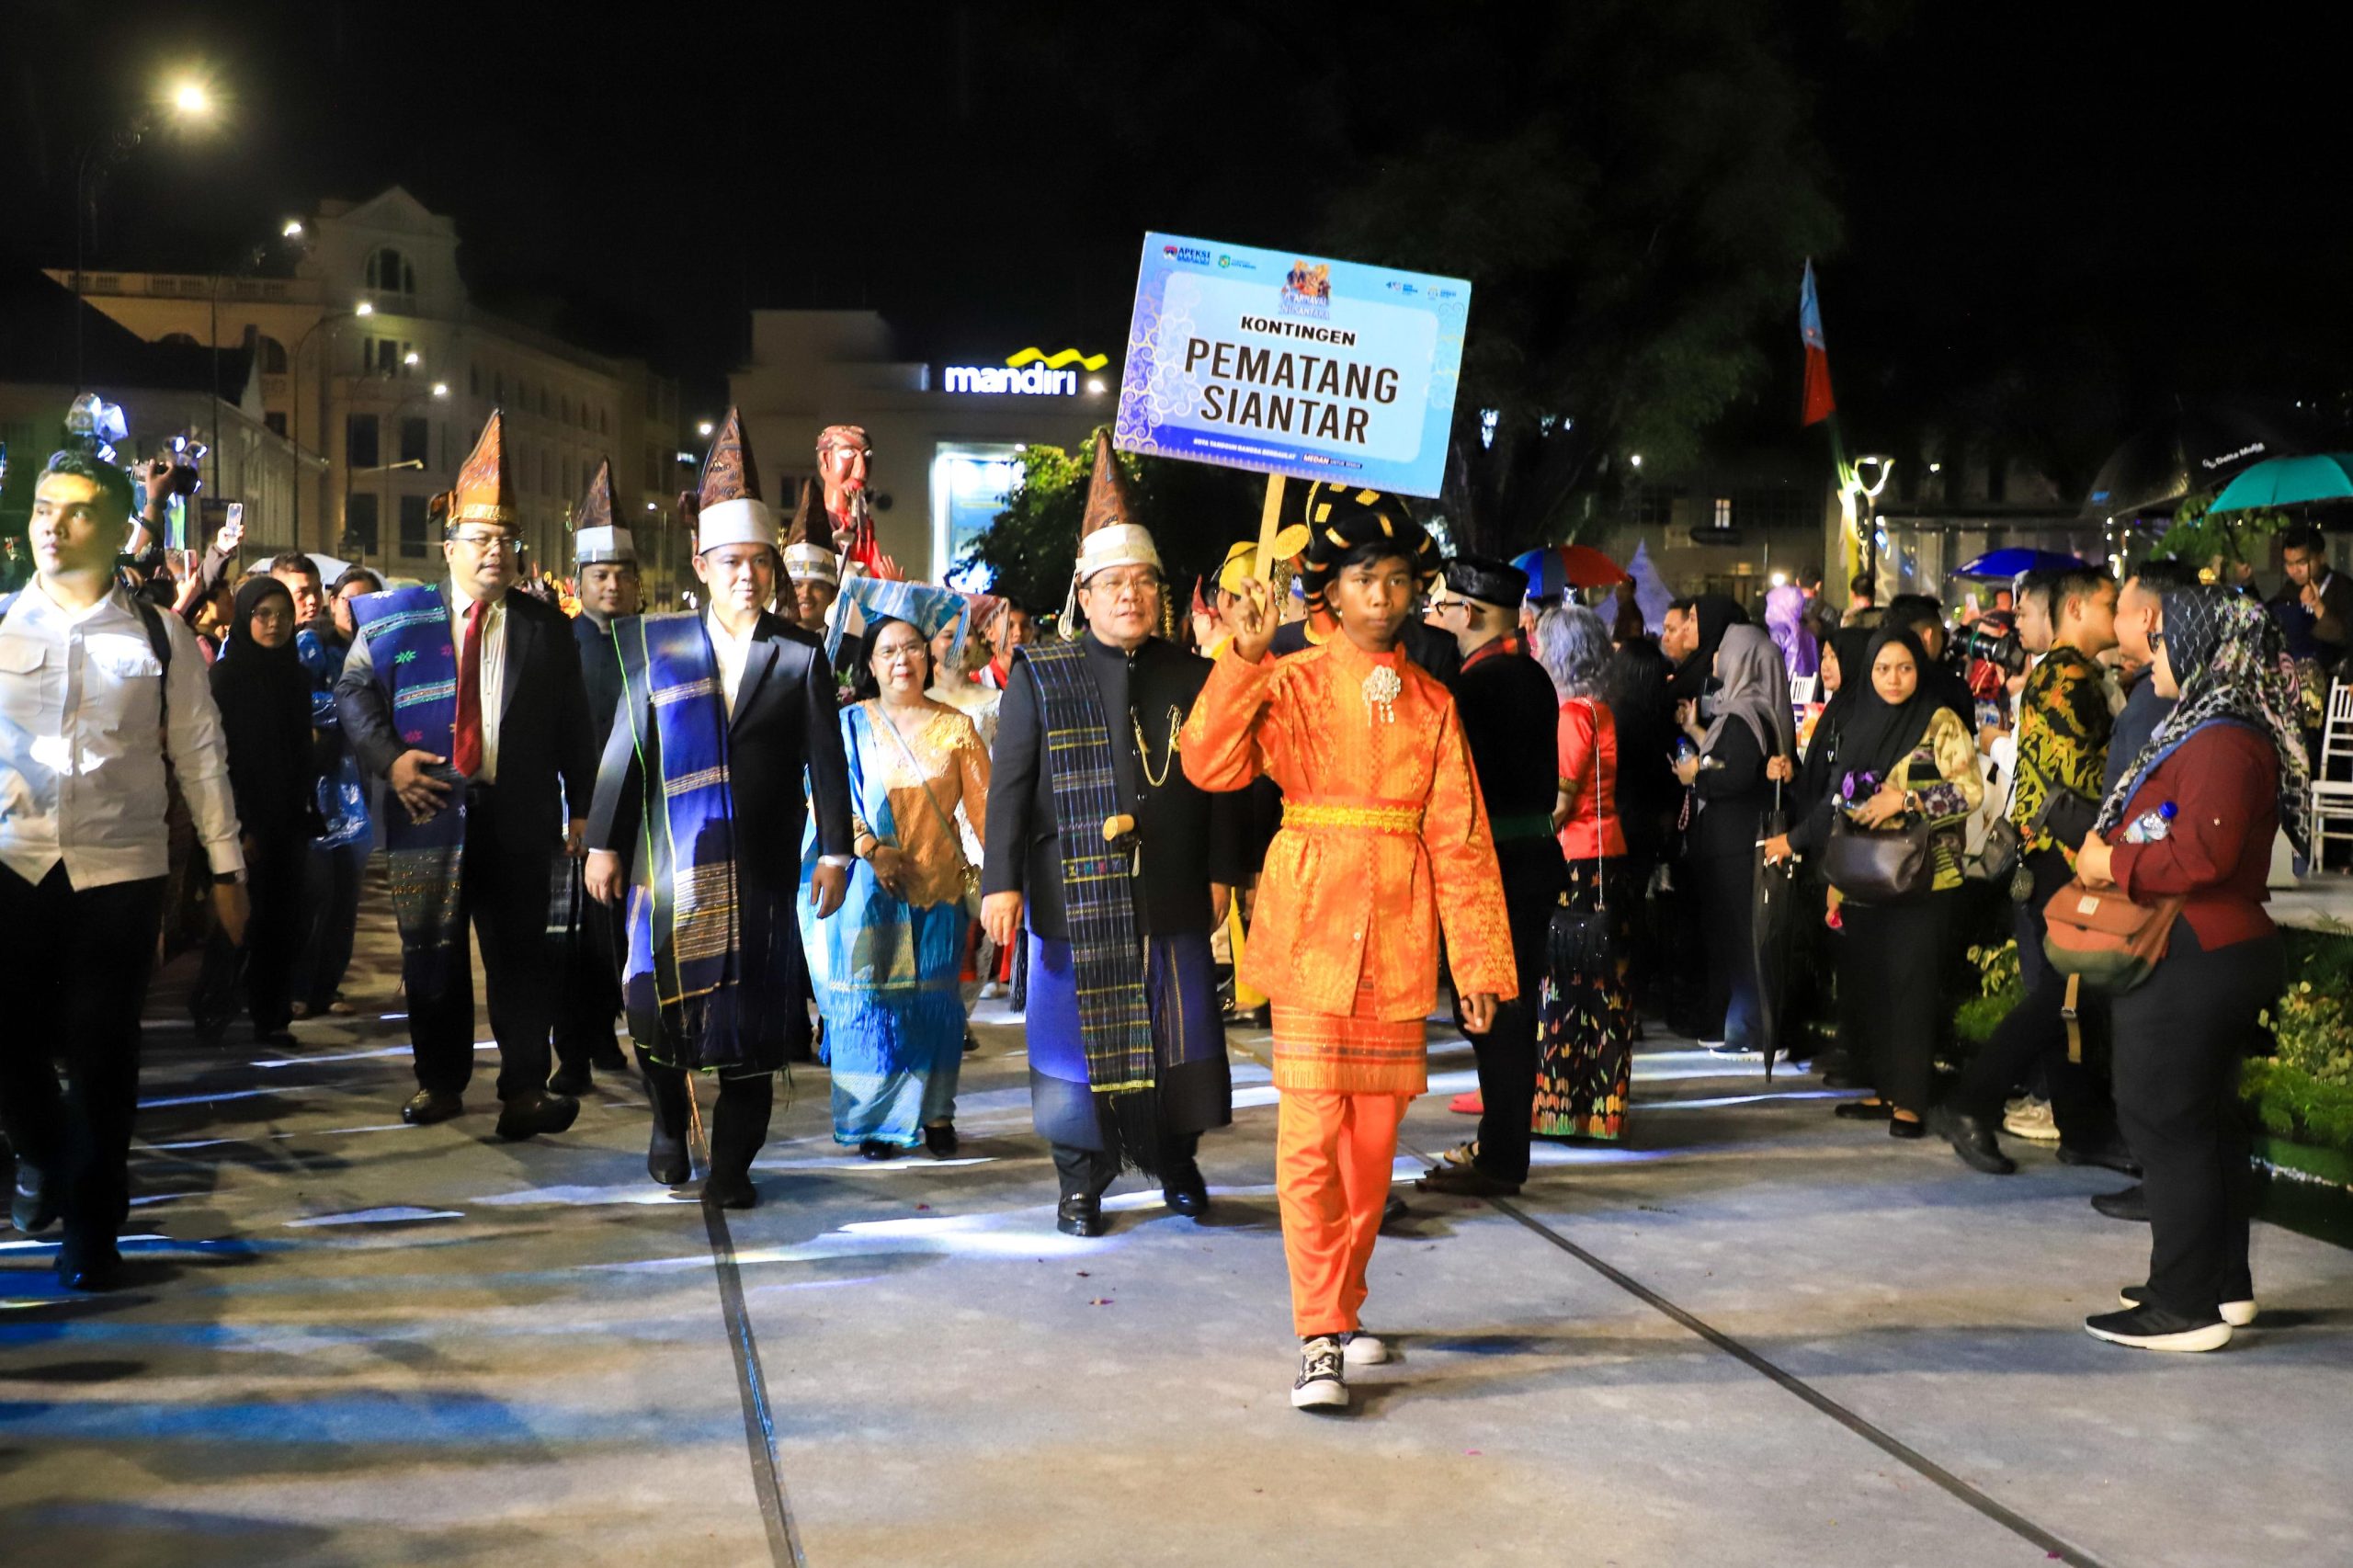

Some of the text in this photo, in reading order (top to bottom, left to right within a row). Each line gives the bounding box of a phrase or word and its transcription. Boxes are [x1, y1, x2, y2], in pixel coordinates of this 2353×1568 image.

[1177, 246, 1211, 258] APEKSI
[1241, 315, 1357, 346] KONTINGEN
[945, 361, 1075, 395] mandiri
[1185, 337, 1399, 404] PEMATANG
[1200, 384, 1370, 445] SIANTAR
